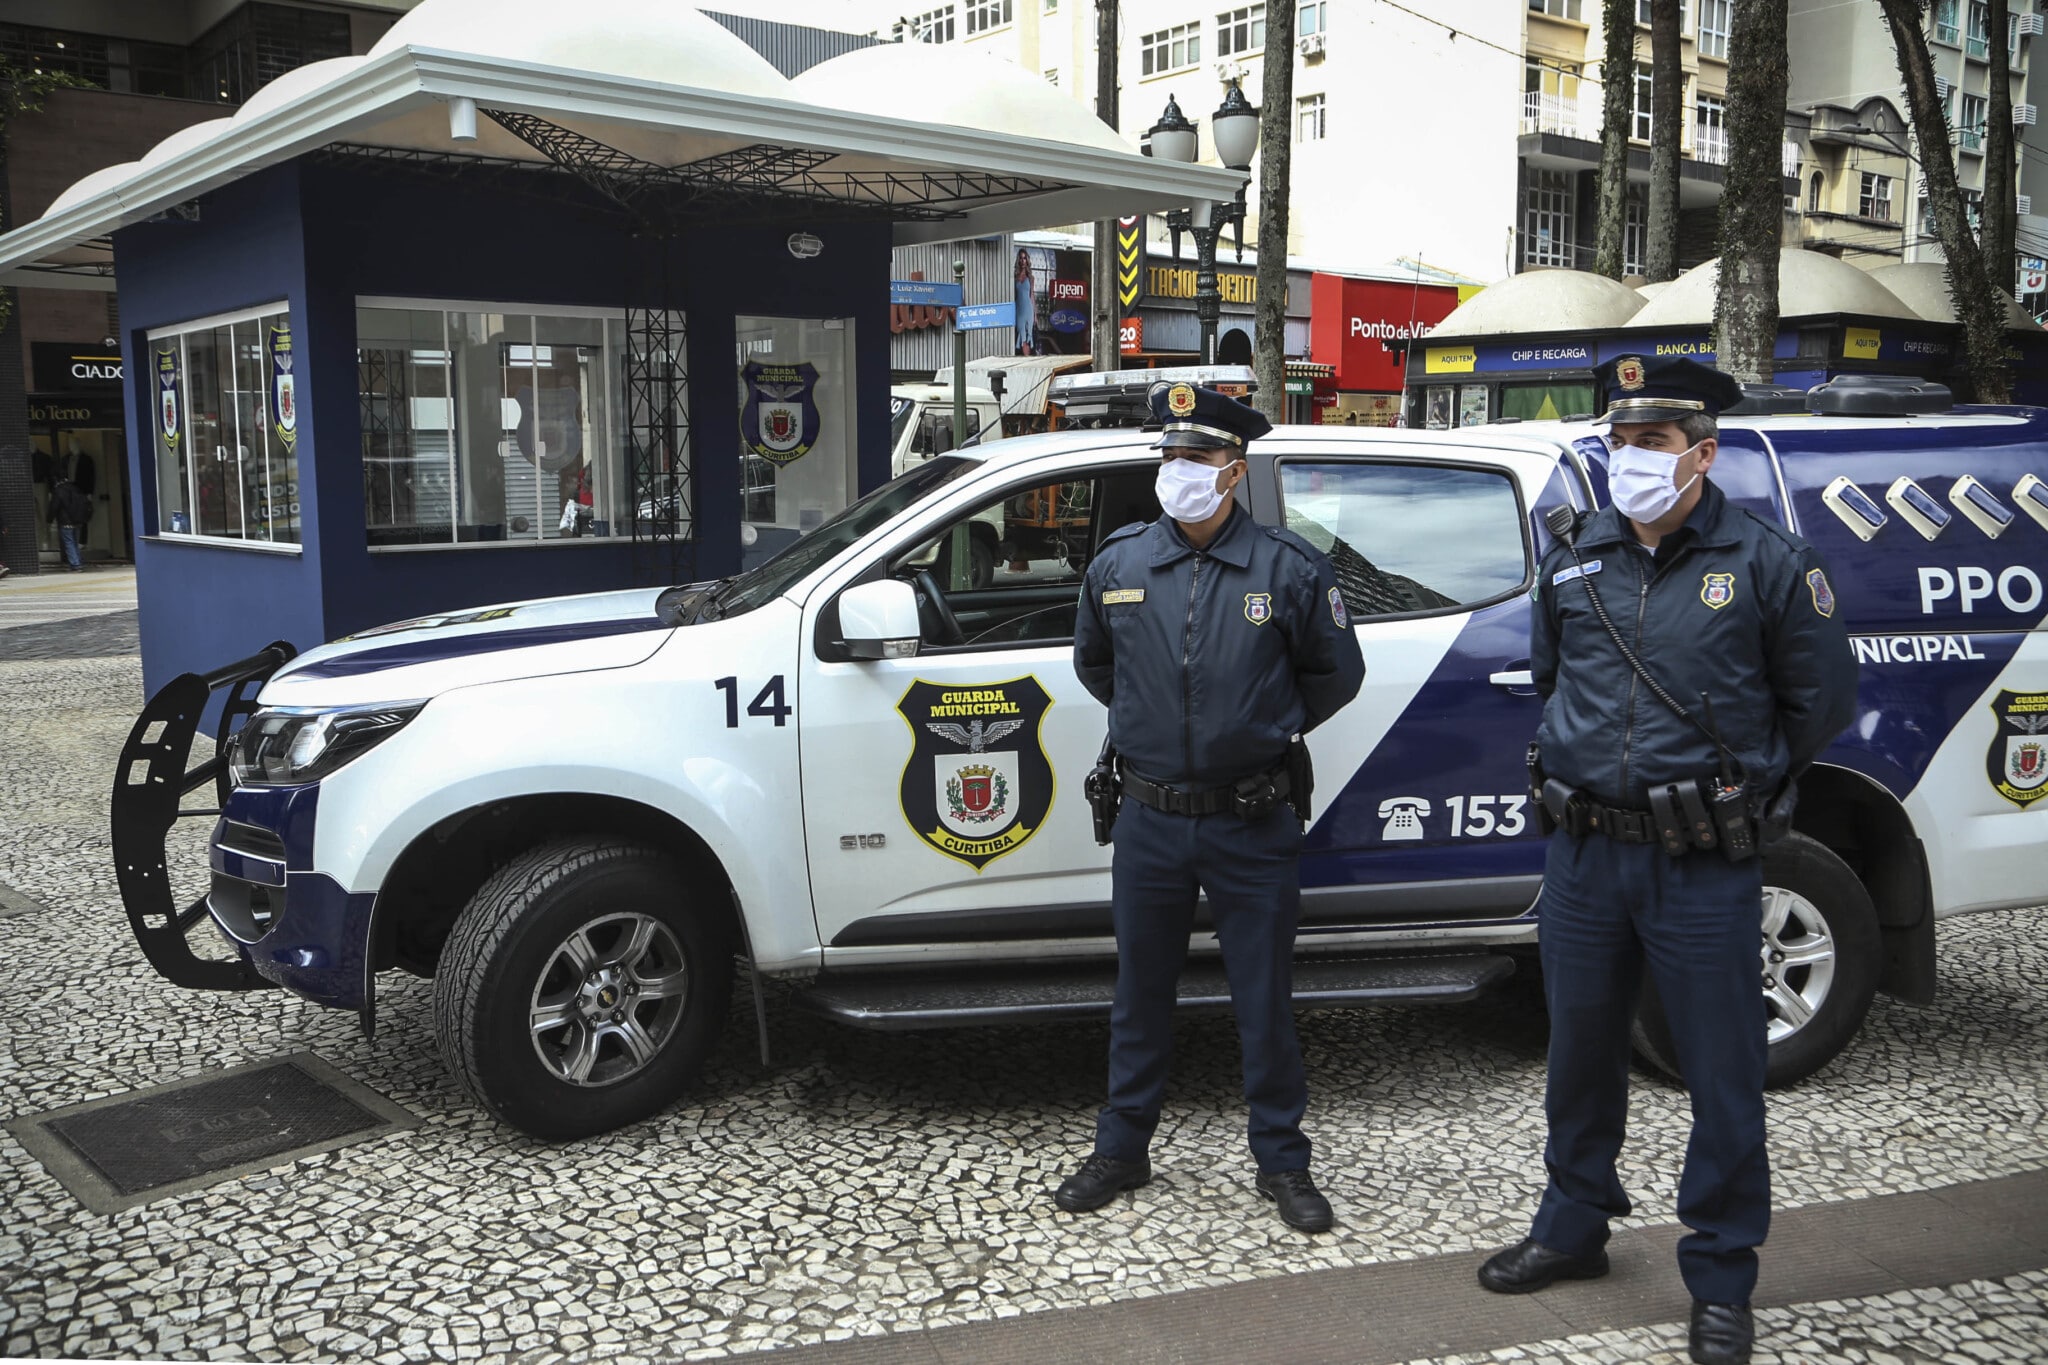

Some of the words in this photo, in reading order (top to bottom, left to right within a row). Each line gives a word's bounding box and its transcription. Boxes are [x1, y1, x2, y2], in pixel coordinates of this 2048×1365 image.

[913, 285, 935, 293] Xavier
[1351, 317, 1396, 339] Ponto
[1396, 325, 1409, 340] de
[1656, 343, 1697, 355] BANCA
[1855, 338, 1867, 348] AQUI
[1867, 339, 1879, 348] TEM
[1903, 341, 1917, 352] CHIP
[1459, 354, 1473, 362] TEM
[1511, 351, 1533, 361] CHIP
[1534, 350, 1540, 360] E
[1542, 348, 1587, 360] RECARGA
[756, 374, 804, 382] MUNICIPAL
[45, 404, 91, 421] Terno
[762, 449, 800, 460] CURITIBA
[1917, 565, 2043, 614] PPO
[1851, 634, 1985, 664] NICIPAL
[714, 675, 793, 728] 14
[941, 689, 1005, 704] GUARDA
[2015, 695, 2048, 705] GUARD
[930, 702, 1021, 718] MUNICIPAL
[2007, 704, 2048, 713] MUNICIP
[2005, 787, 2045, 799] CURITIBA
[1445, 795, 1527, 837] 153
[839, 833, 887, 850] S10
[944, 836, 1014, 854] CURITIBA
